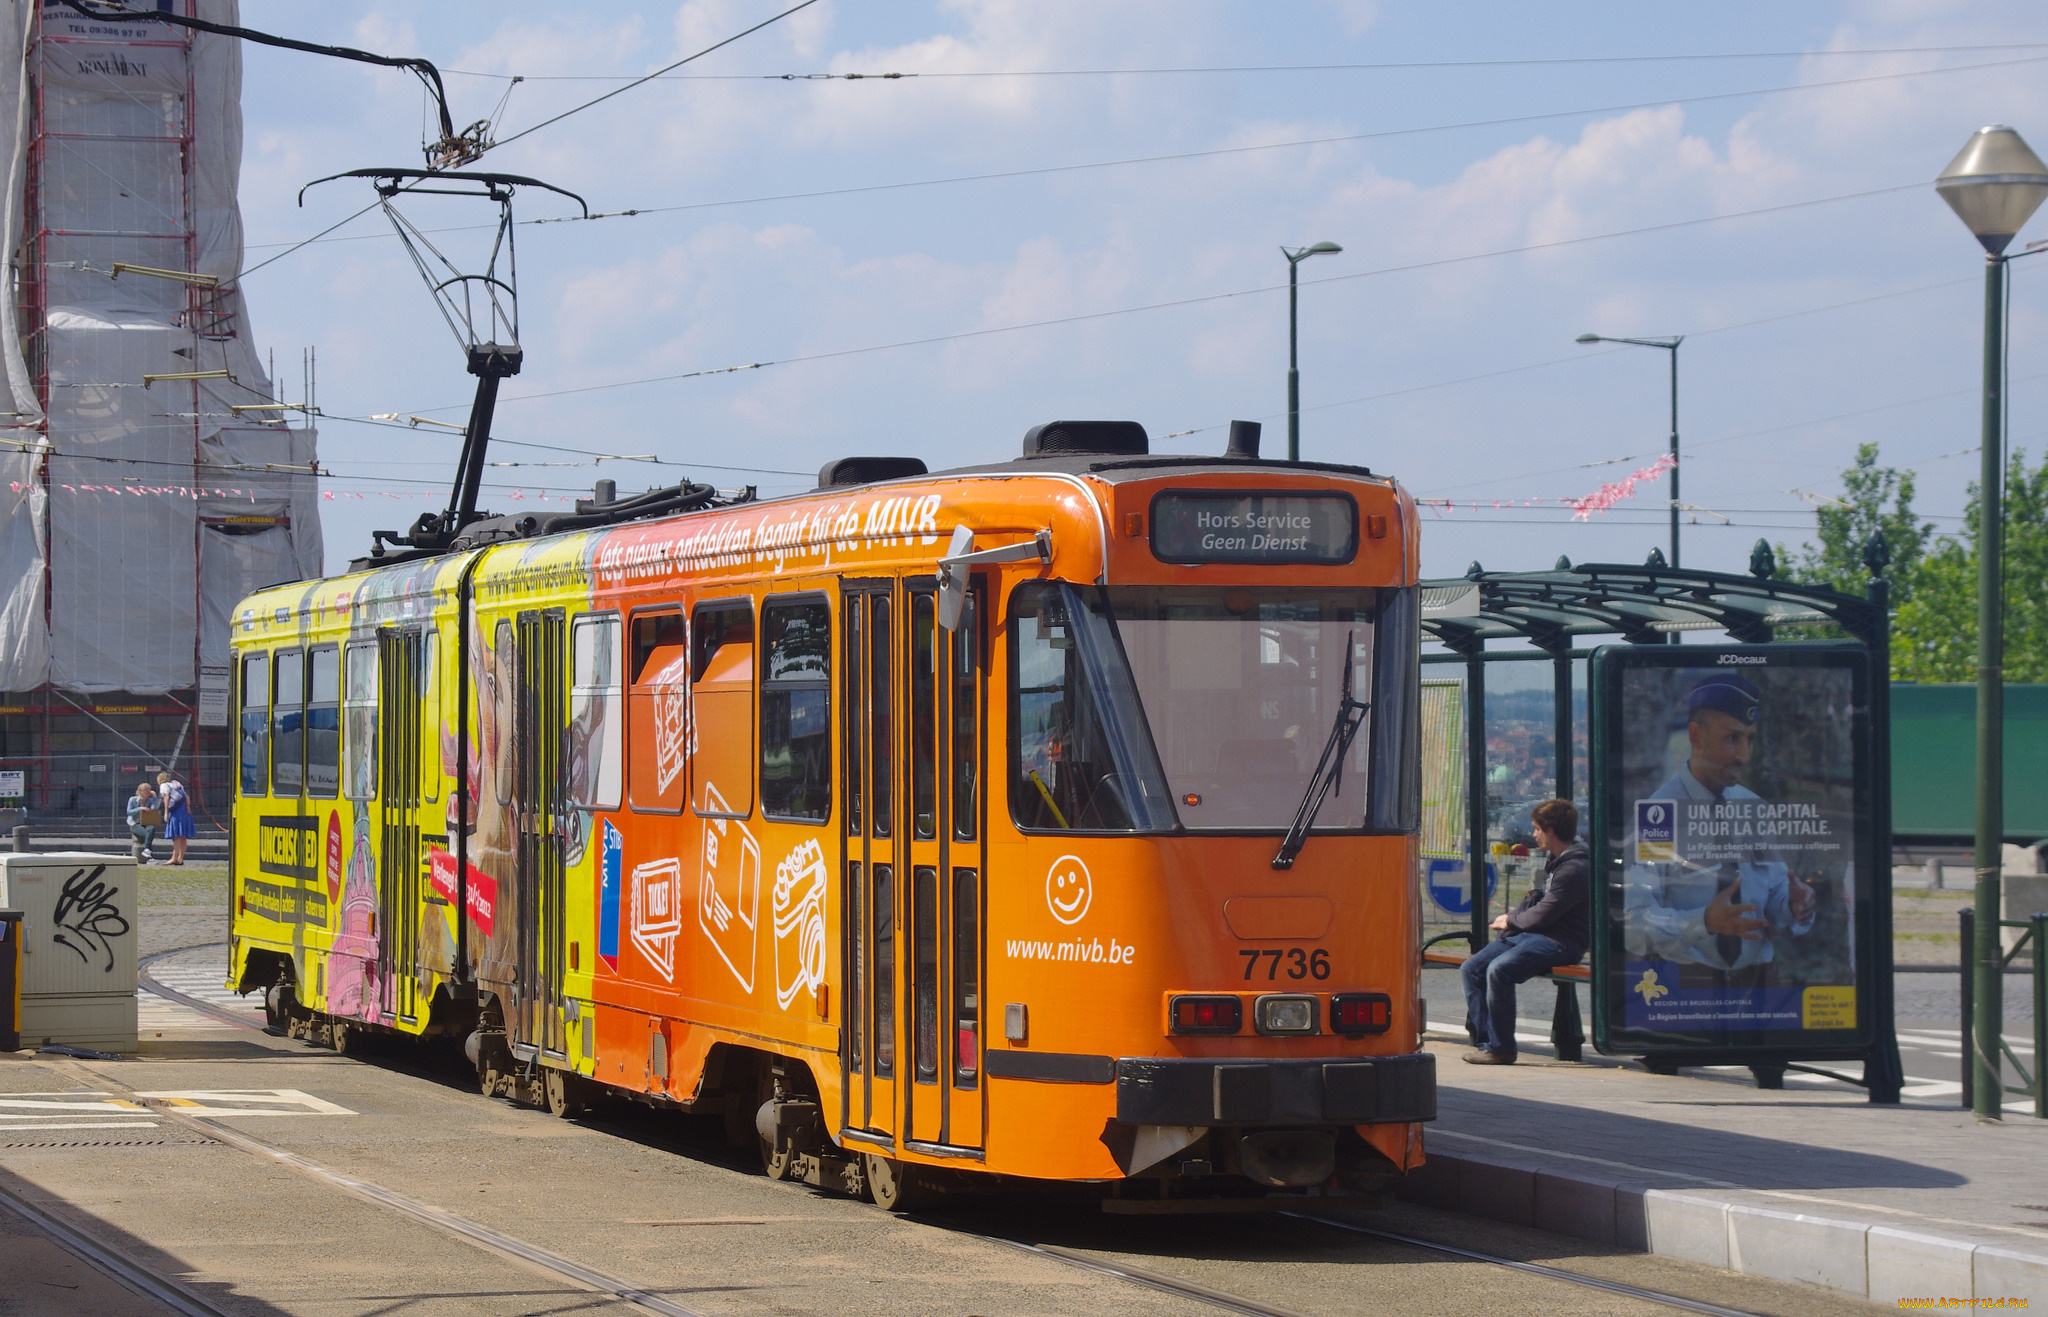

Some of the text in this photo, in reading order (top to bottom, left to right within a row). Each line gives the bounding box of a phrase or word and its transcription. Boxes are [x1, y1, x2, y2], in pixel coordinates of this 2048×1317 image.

[69, 25, 86, 33] TEL
[122, 29, 134, 37] 97
[136, 30, 148, 38] 67
[1197, 511, 1312, 529] Hors Service
[624, 535, 673, 579] nieuws
[674, 518, 752, 573] ontdekken
[753, 510, 810, 574] begint
[808, 504, 840, 568] bij
[833, 501, 859, 552] de
[863, 494, 942, 550] MIVB
[1202, 533, 1308, 550] Geen Dienst
[1717, 654, 1767, 664] JCDecaux
[1687, 801, 1820, 819] UN RÔLE CAPITAL
[1642, 828, 1670, 838] Police
[1687, 820, 1832, 836] POUR LA CAPITALE.
[609, 828, 622, 850] STIB
[1698, 843, 1722, 851] Police
[433, 858, 455, 893] Verlengd
[647, 881, 669, 917] TICKET
[1007, 937, 1135, 964] www.mivb.be
[1239, 948, 1331, 980] 7736
